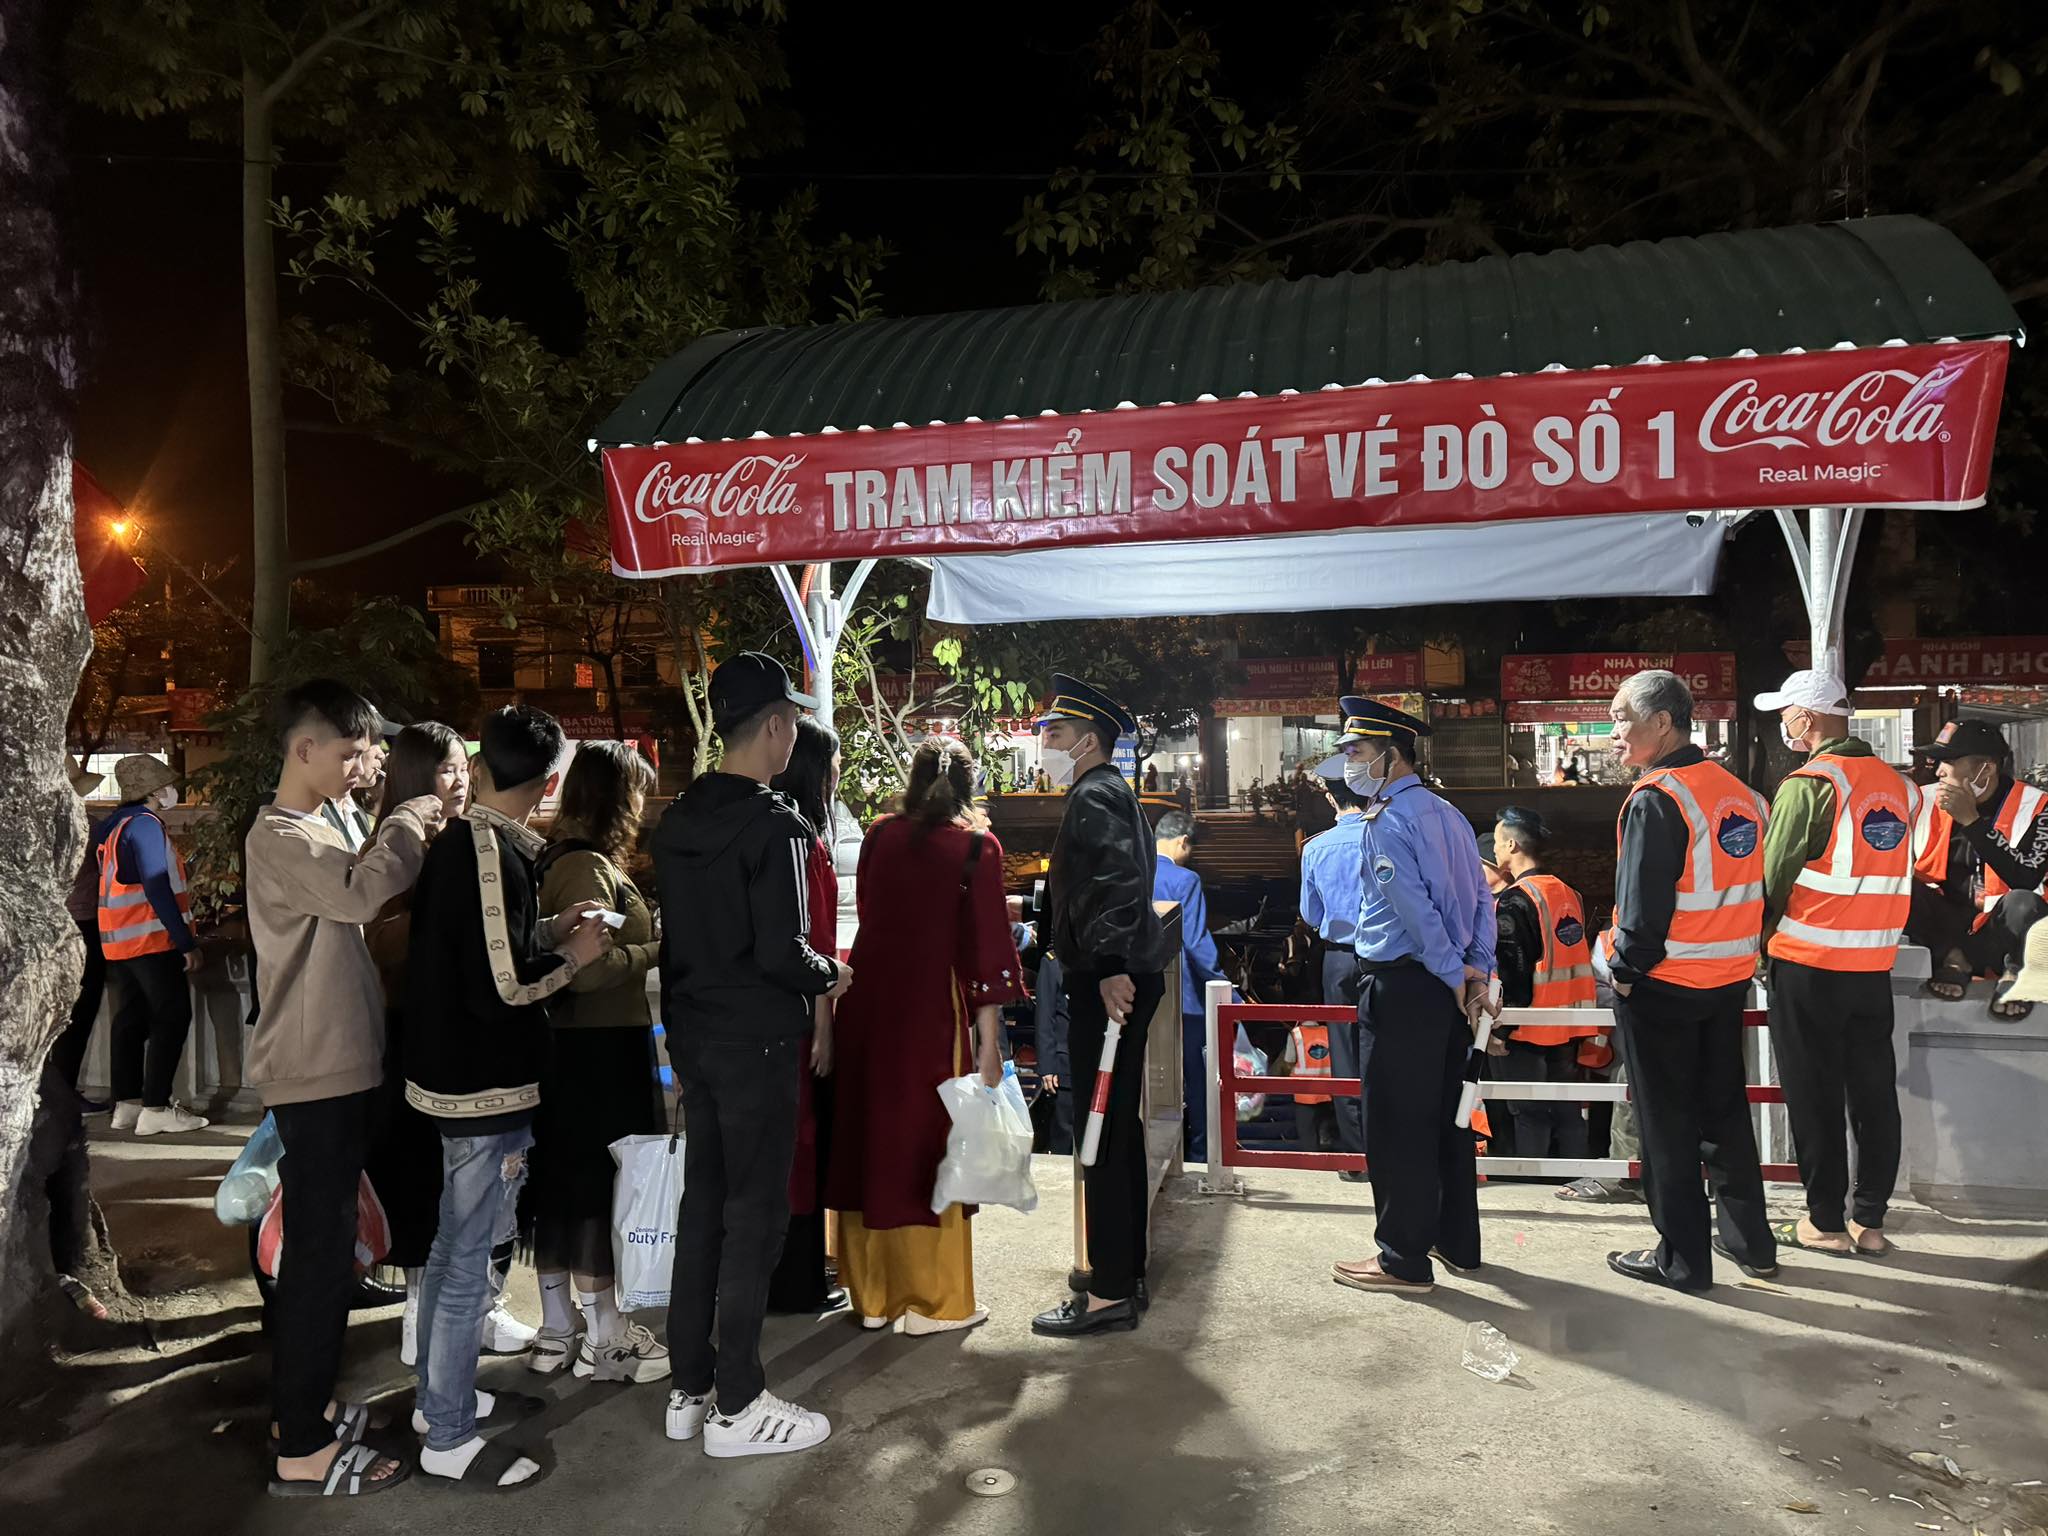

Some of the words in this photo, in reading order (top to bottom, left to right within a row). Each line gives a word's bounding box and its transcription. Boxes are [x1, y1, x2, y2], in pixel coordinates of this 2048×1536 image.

[1700, 367, 1964, 454] Coca-Cola
[825, 464, 972, 542] TRẠM
[992, 428, 1131, 522] KIỂM
[1152, 425, 1304, 511] SOÁT
[1324, 414, 1399, 499] VÉ
[1420, 404, 1508, 491] ĐÒ
[1532, 387, 1623, 487] SỐ
[1647, 411, 1675, 479] 1
[1758, 465, 1808, 483] Real
[1814, 463, 1881, 482] Magic
[635, 453, 807, 523] Coca-Cola
[671, 533, 706, 547] Real
[709, 530, 755, 546] Magic
[1604, 657, 1635, 669] NHÀ
[628, 1231, 658, 1245] Duty
[661, 1231, 676, 1243] Fr
